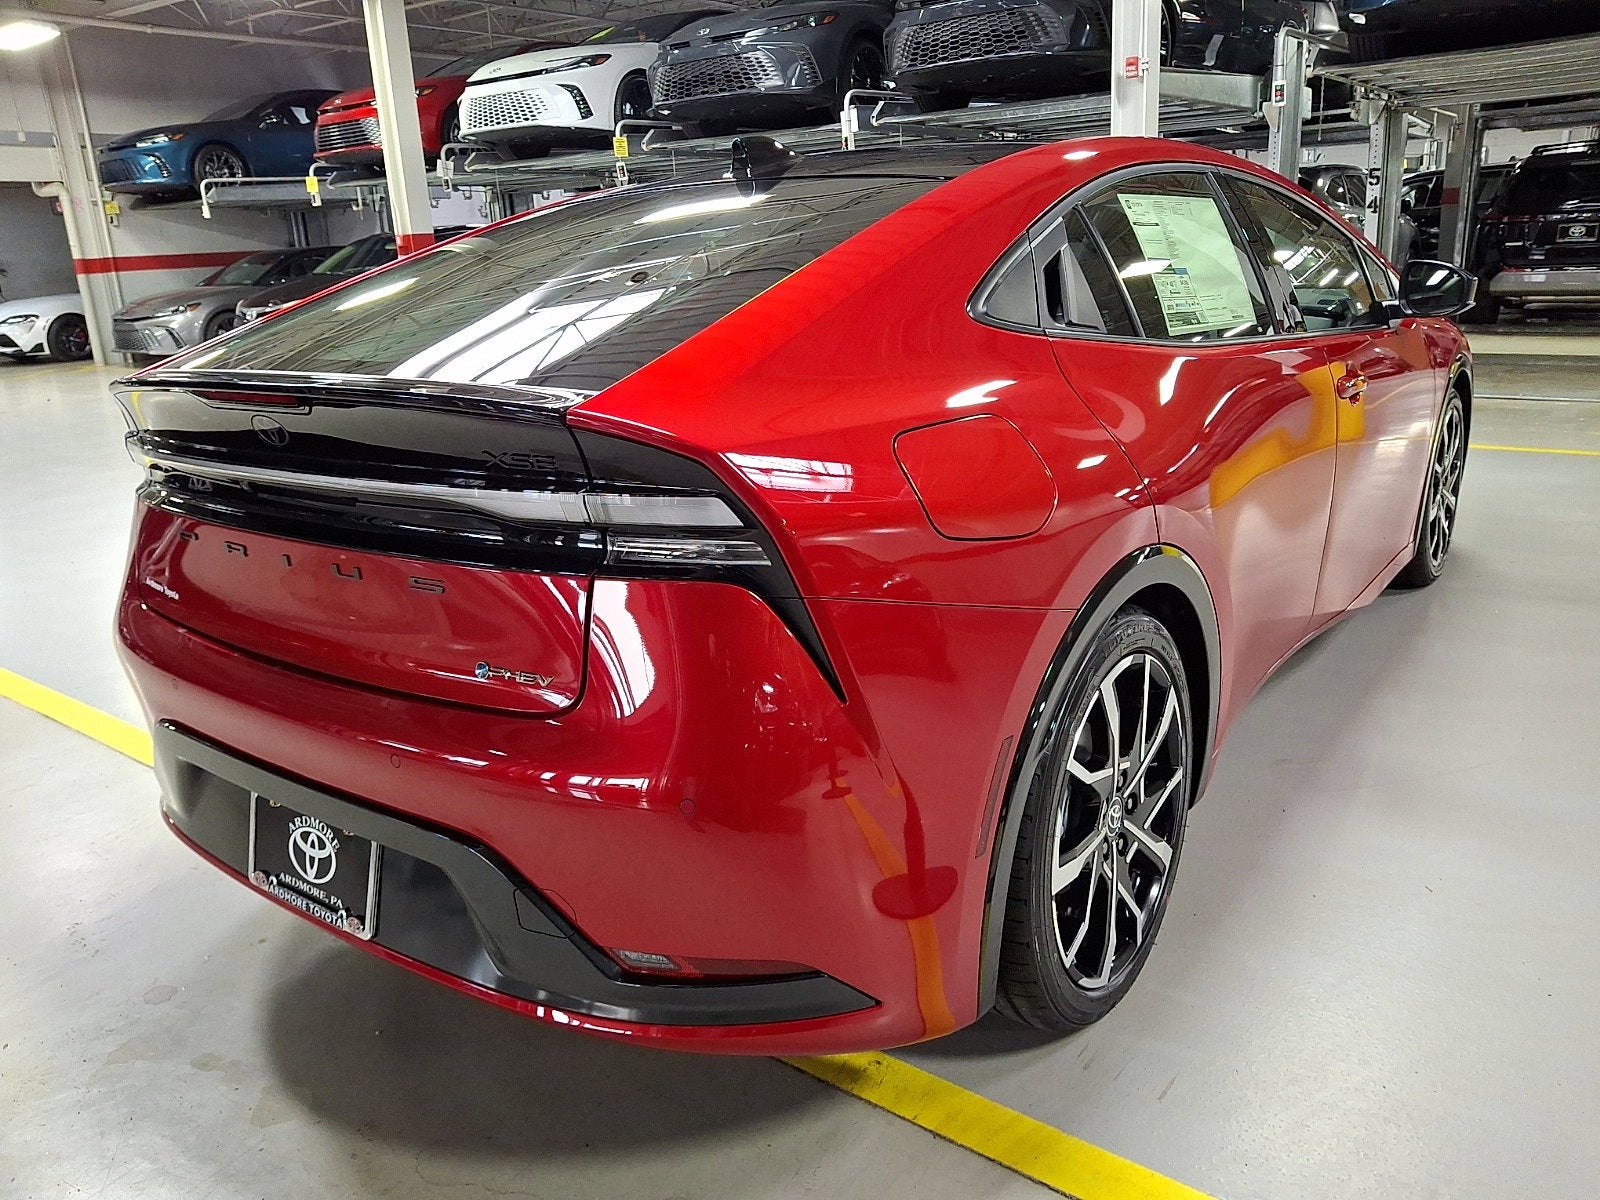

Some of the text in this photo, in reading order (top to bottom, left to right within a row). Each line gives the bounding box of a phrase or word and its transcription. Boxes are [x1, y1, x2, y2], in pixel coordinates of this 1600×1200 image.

[1368, 167, 1382, 186] 5
[1366, 195, 1379, 214] 4
[481, 449, 559, 471] XSE
[180, 530, 446, 594] PRIUS
[288, 815, 341, 853] ARDMORE
[268, 885, 345, 930] ARDMORE TOYOTA
[279, 872, 344, 910] ARDMORE, PA
